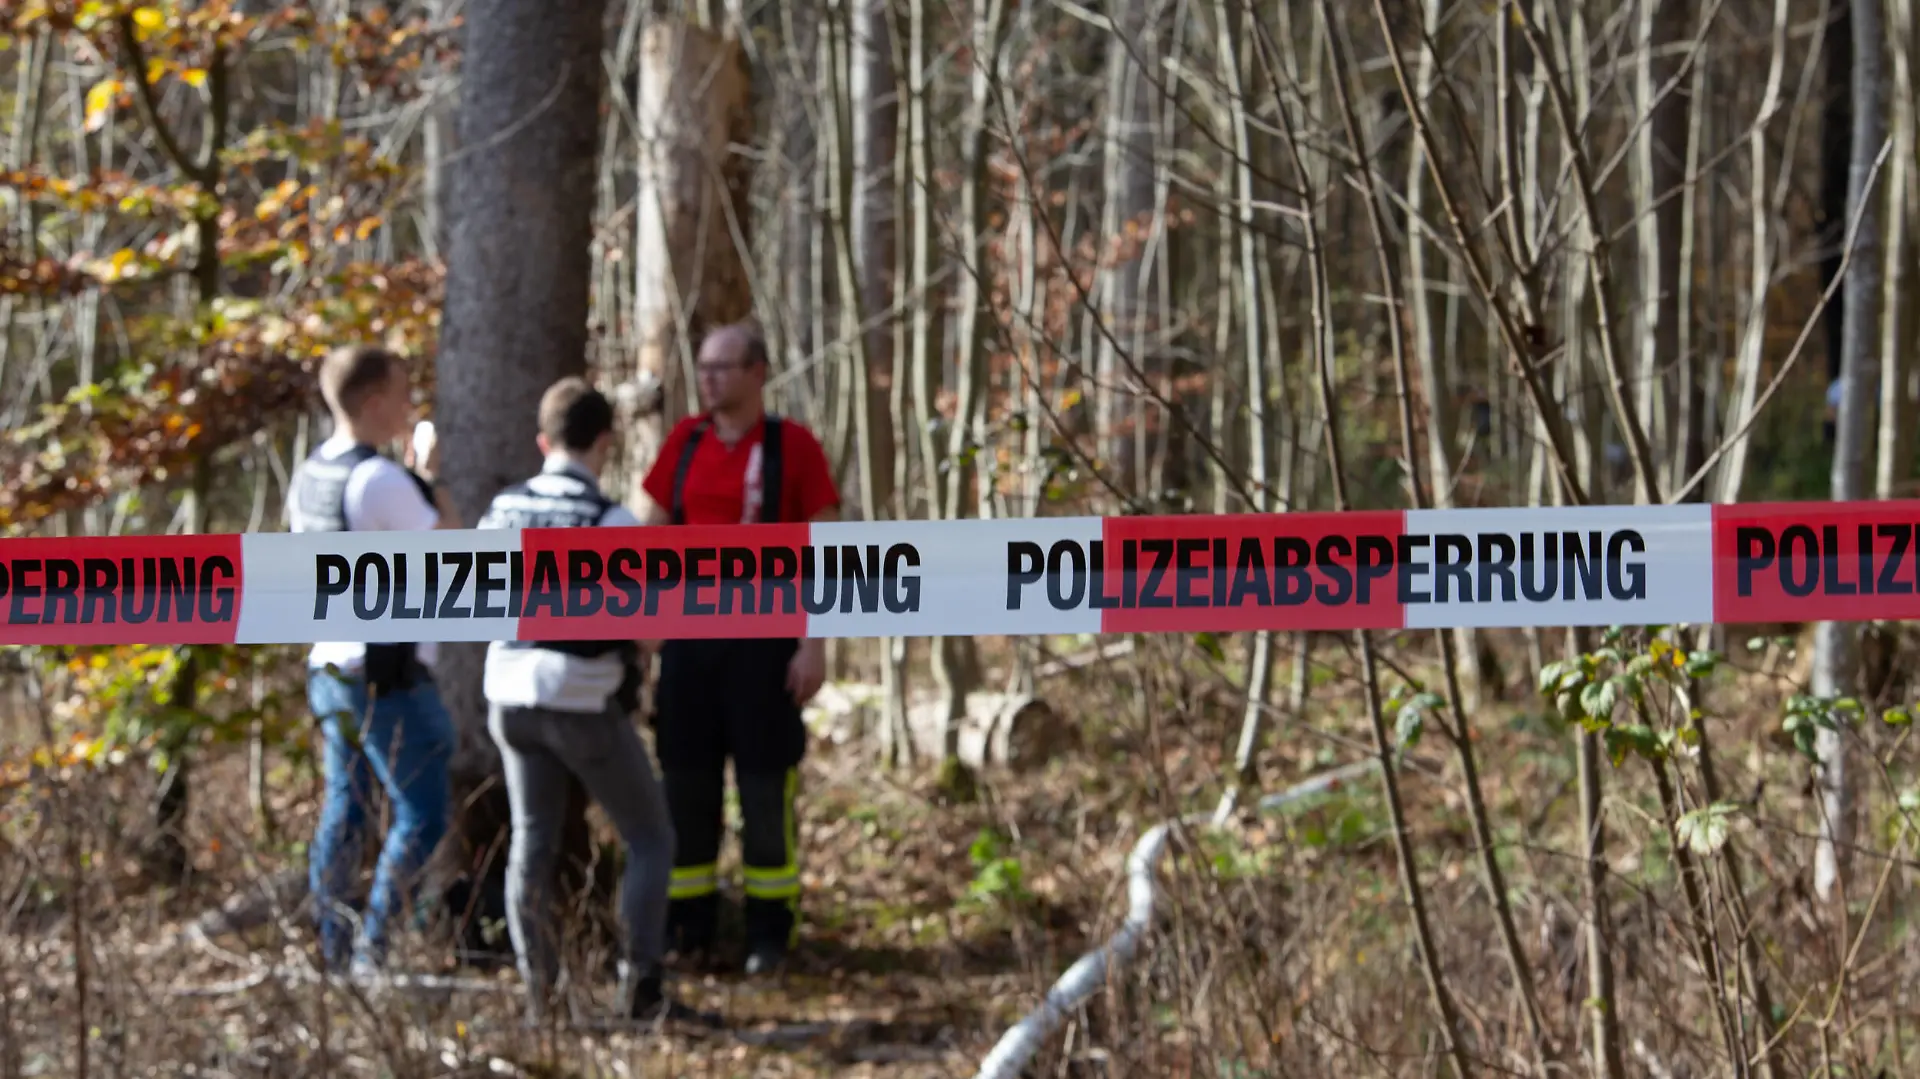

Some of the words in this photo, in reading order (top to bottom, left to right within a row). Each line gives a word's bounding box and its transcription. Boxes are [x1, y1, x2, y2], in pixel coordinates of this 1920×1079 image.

[0, 555, 235, 625] ERRUNG
[313, 542, 921, 620] POLIZEIABSPERRUNG
[1006, 529, 1646, 611] POLIZEIABSPERRUNG
[1737, 524, 1920, 597] POLIZ
